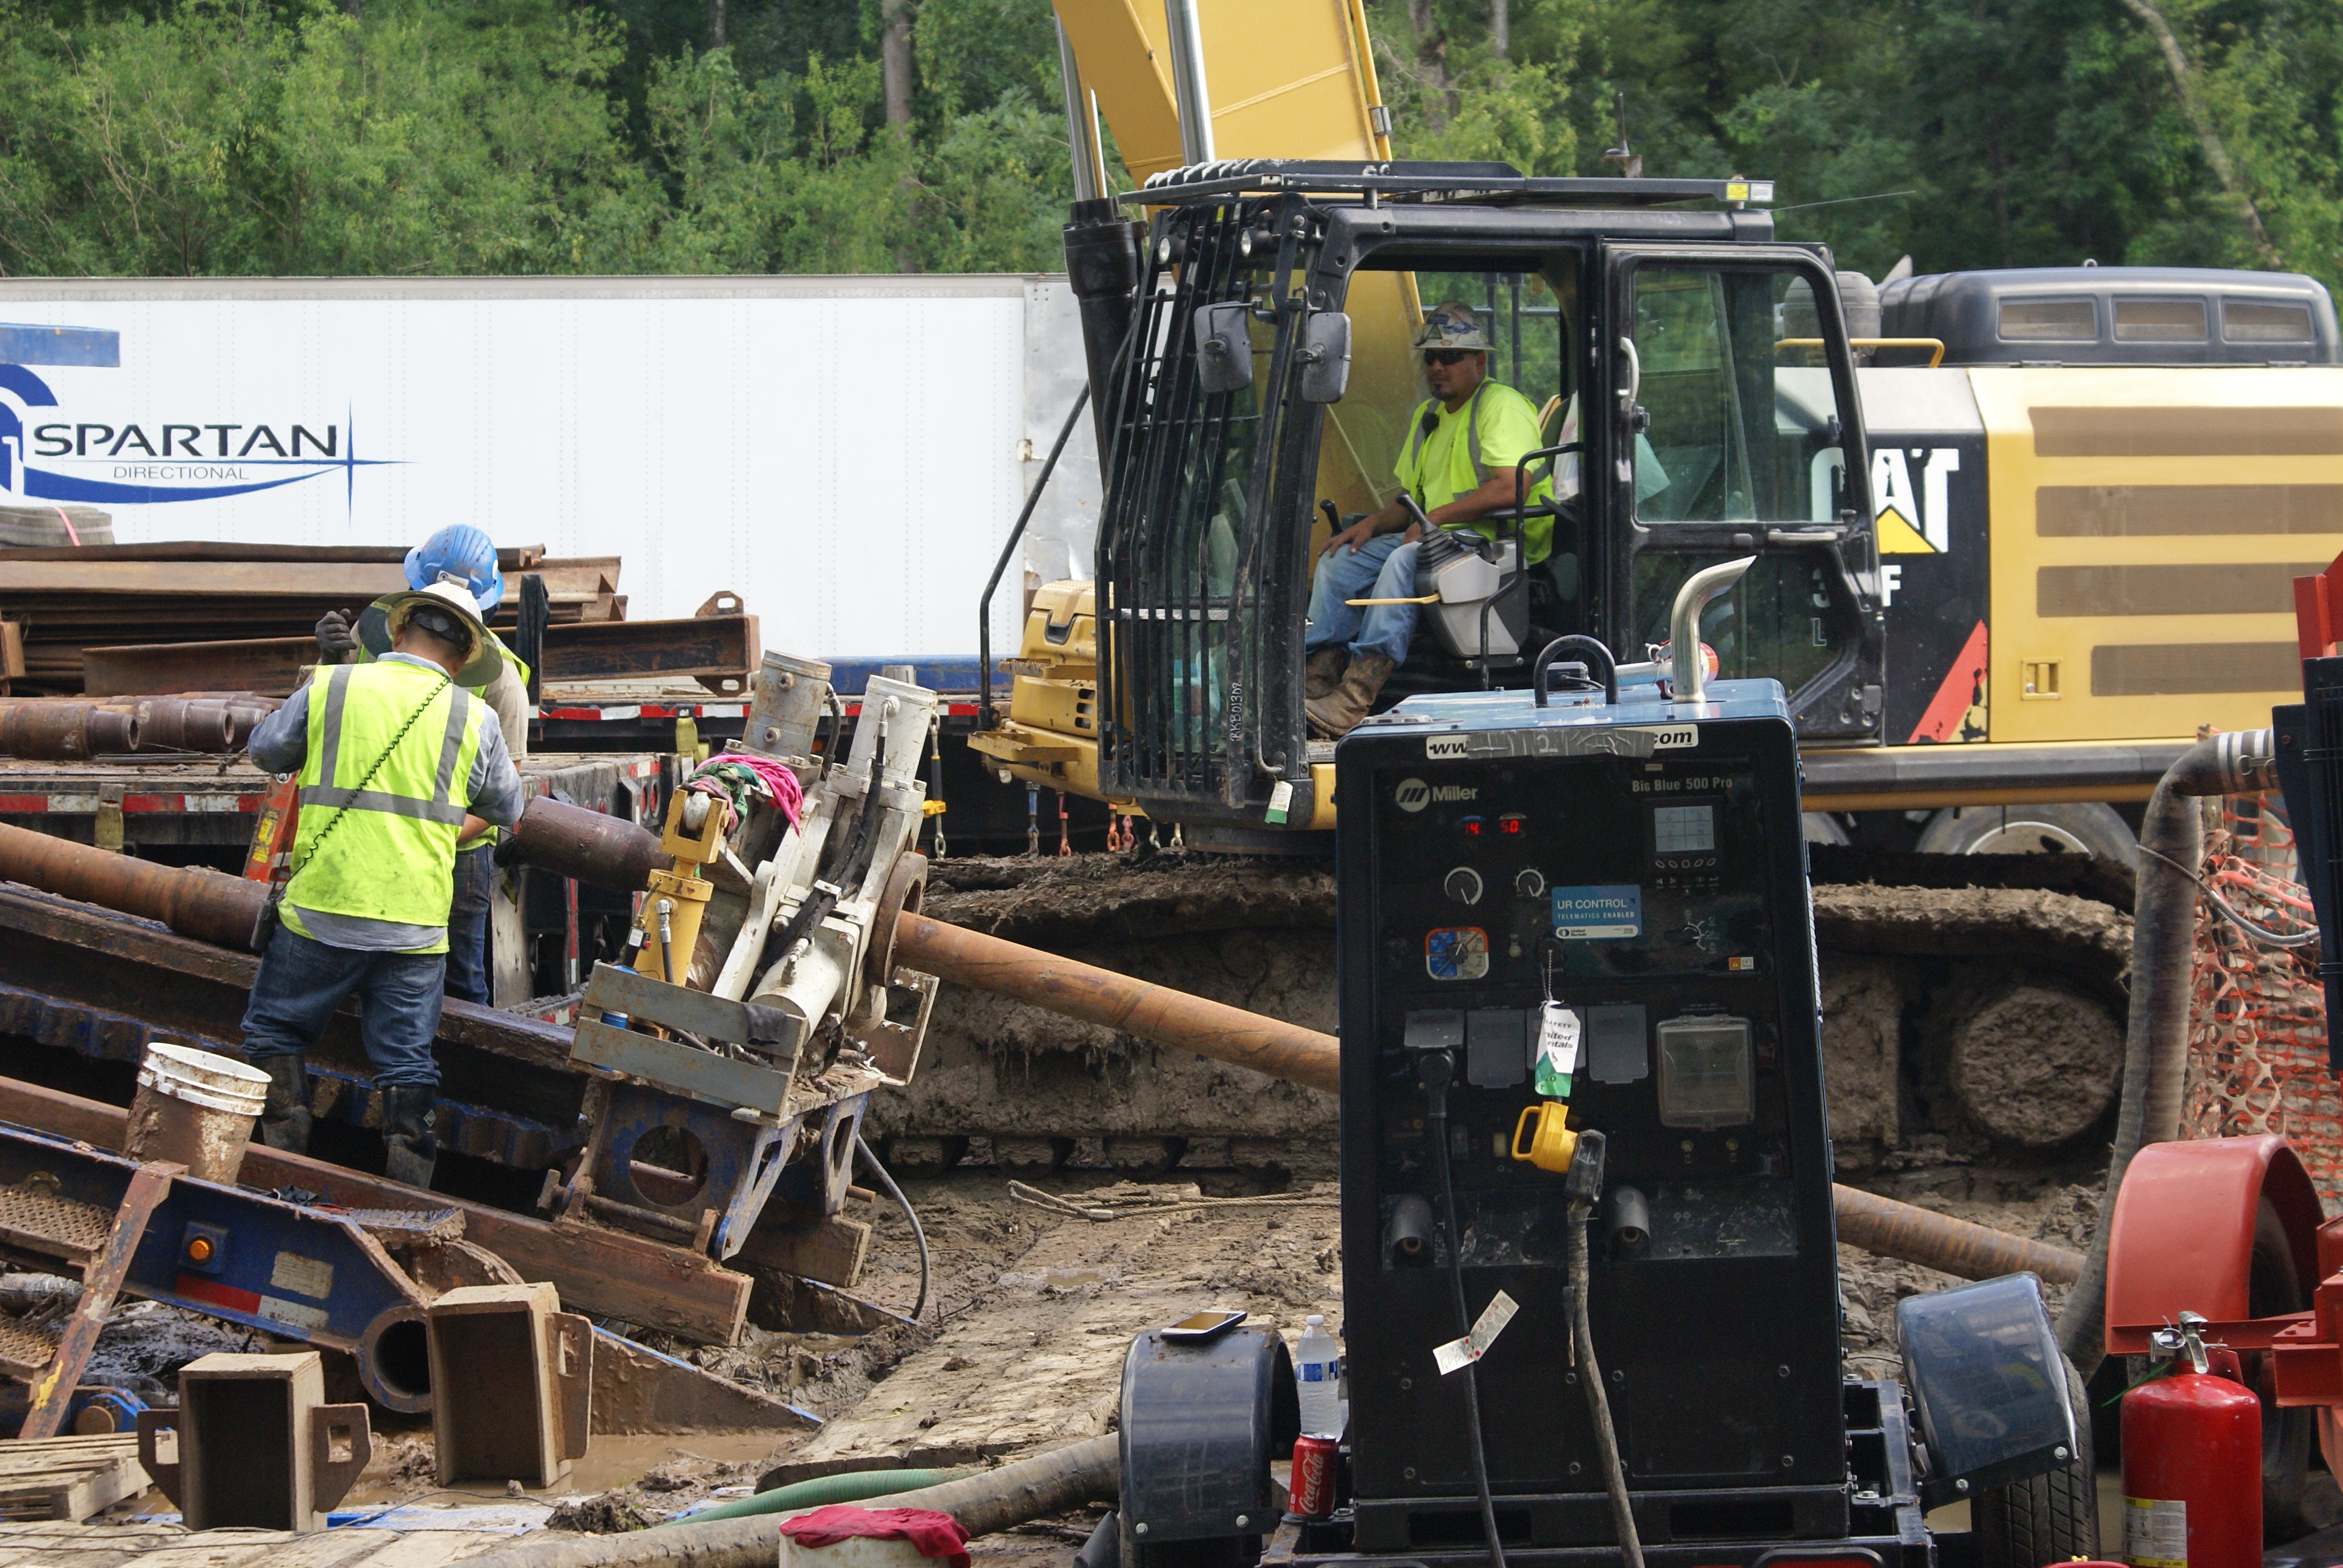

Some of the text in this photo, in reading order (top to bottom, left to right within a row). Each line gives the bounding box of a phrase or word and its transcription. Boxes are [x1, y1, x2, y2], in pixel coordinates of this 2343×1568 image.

[34, 424, 336, 457] SPARTAN
[113, 465, 250, 480] DIRECTIONAL
[1654, 779, 1680, 791] Blue
[1685, 777, 1709, 790] 500
[1712, 776, 1733, 788] Pro
[1432, 785, 1478, 802] Miller
[1557, 898, 1627, 910] UR CONTROL
[1545, 1031, 1575, 1040] nited
